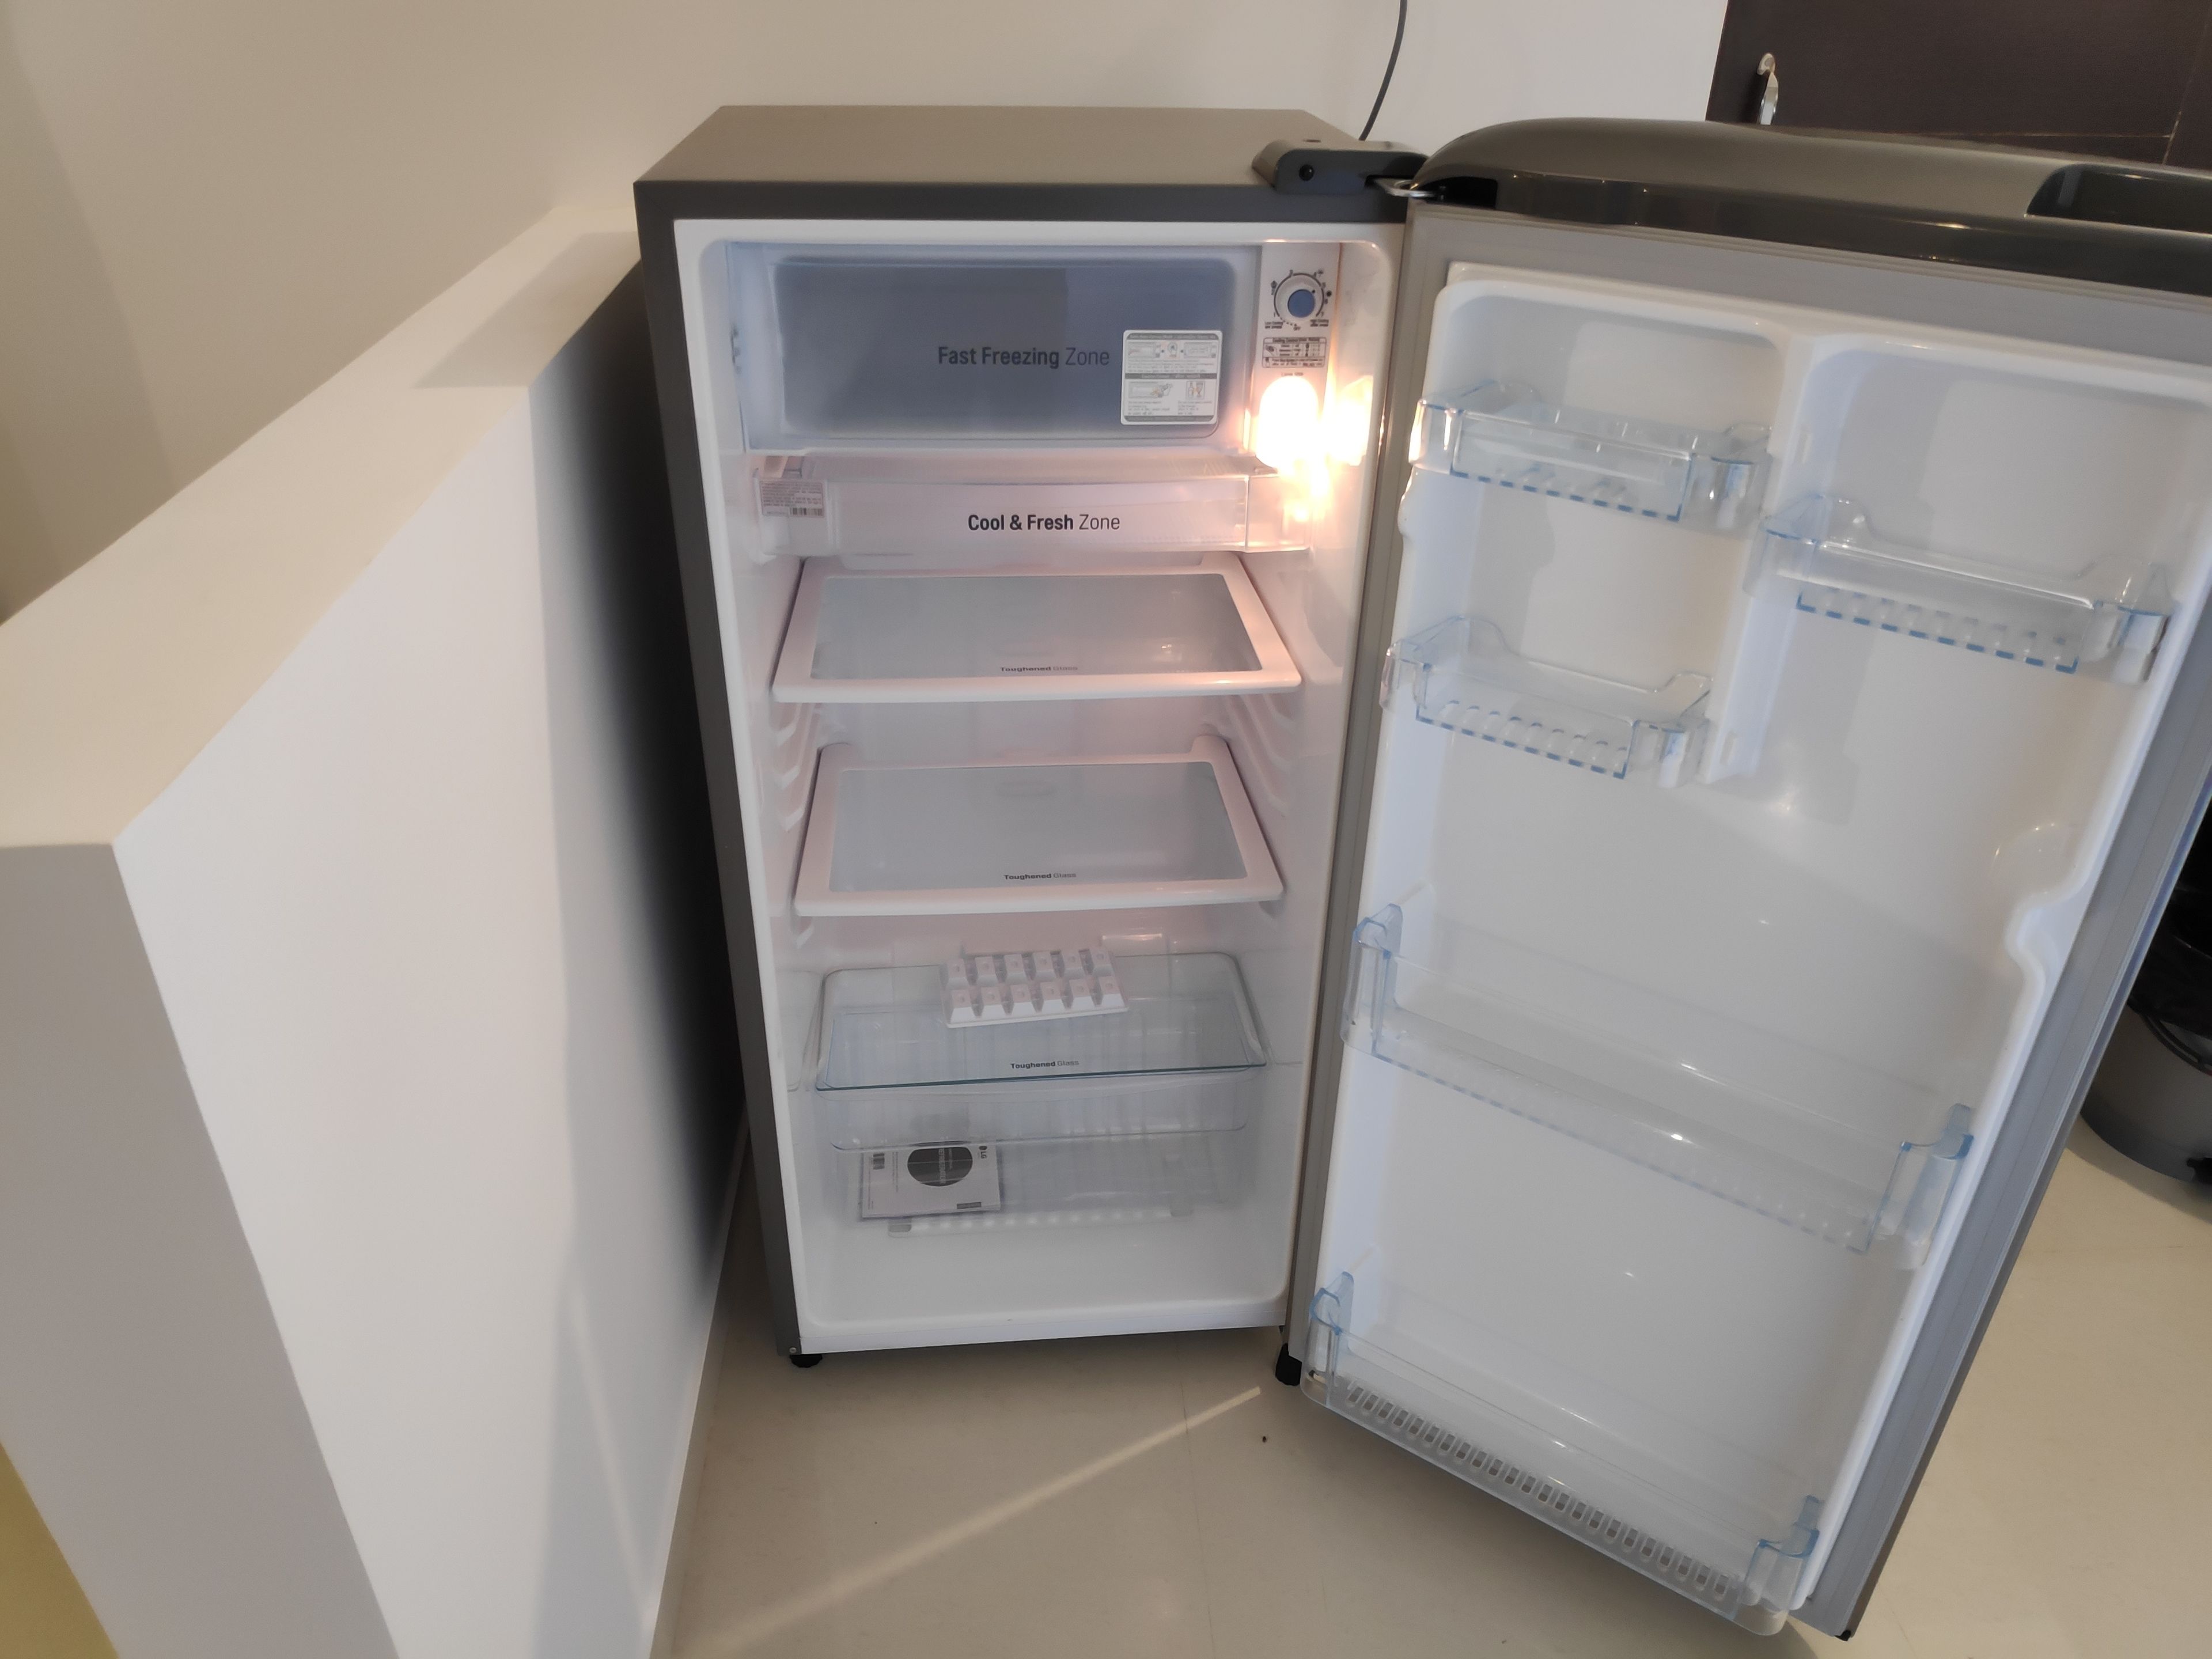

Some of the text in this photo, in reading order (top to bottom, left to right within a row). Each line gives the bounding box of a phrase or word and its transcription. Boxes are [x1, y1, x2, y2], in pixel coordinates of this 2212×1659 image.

[938, 346, 977, 365] Fast
[981, 346, 1060, 369] Freezing
[1065, 347, 1110, 366] Zone
[968, 514, 1120, 531] Cool & Fresh Zone
